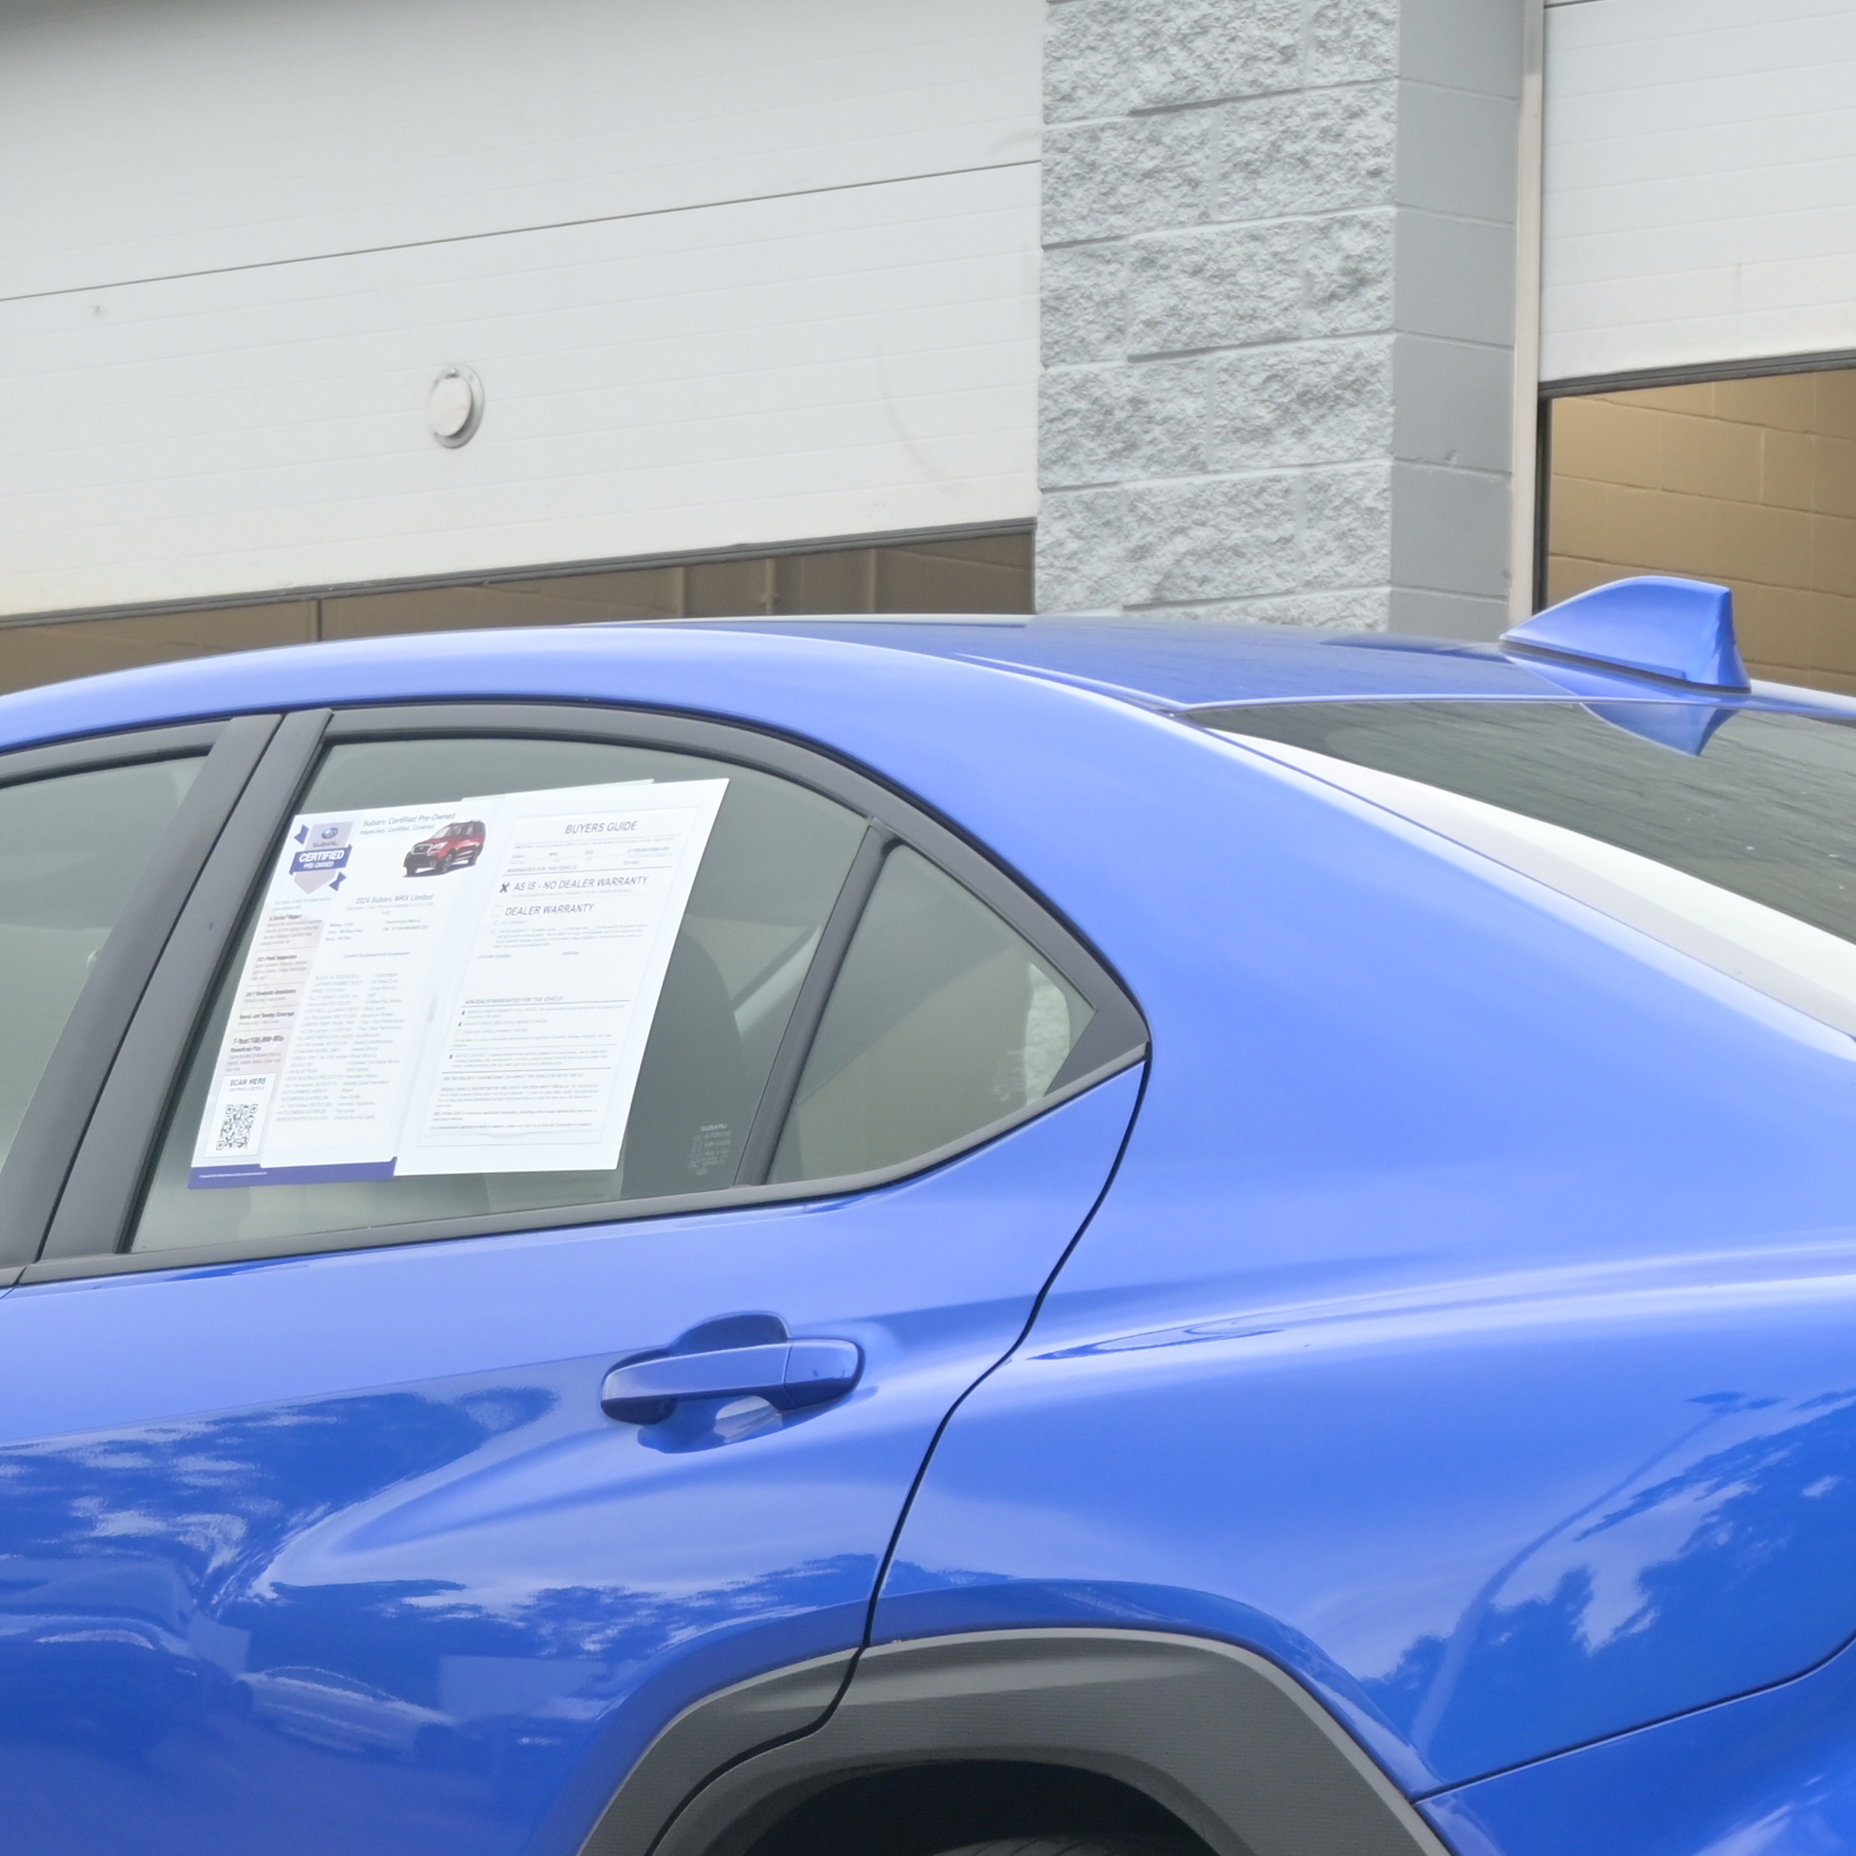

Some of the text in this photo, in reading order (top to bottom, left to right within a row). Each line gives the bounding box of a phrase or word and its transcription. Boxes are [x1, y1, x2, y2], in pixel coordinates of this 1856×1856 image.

[565, 820, 638, 834] BUYERS GUIDE
[299, 850, 345, 863] CERTIFIED
[513, 881, 526, 891] AS
[527, 881, 537, 891] IS
[542, 879, 557, 890] NO
[558, 878, 595, 889] DEALER
[596, 876, 649, 887] WARRANTY
[505, 903, 594, 916] DEALER WARRANTY
